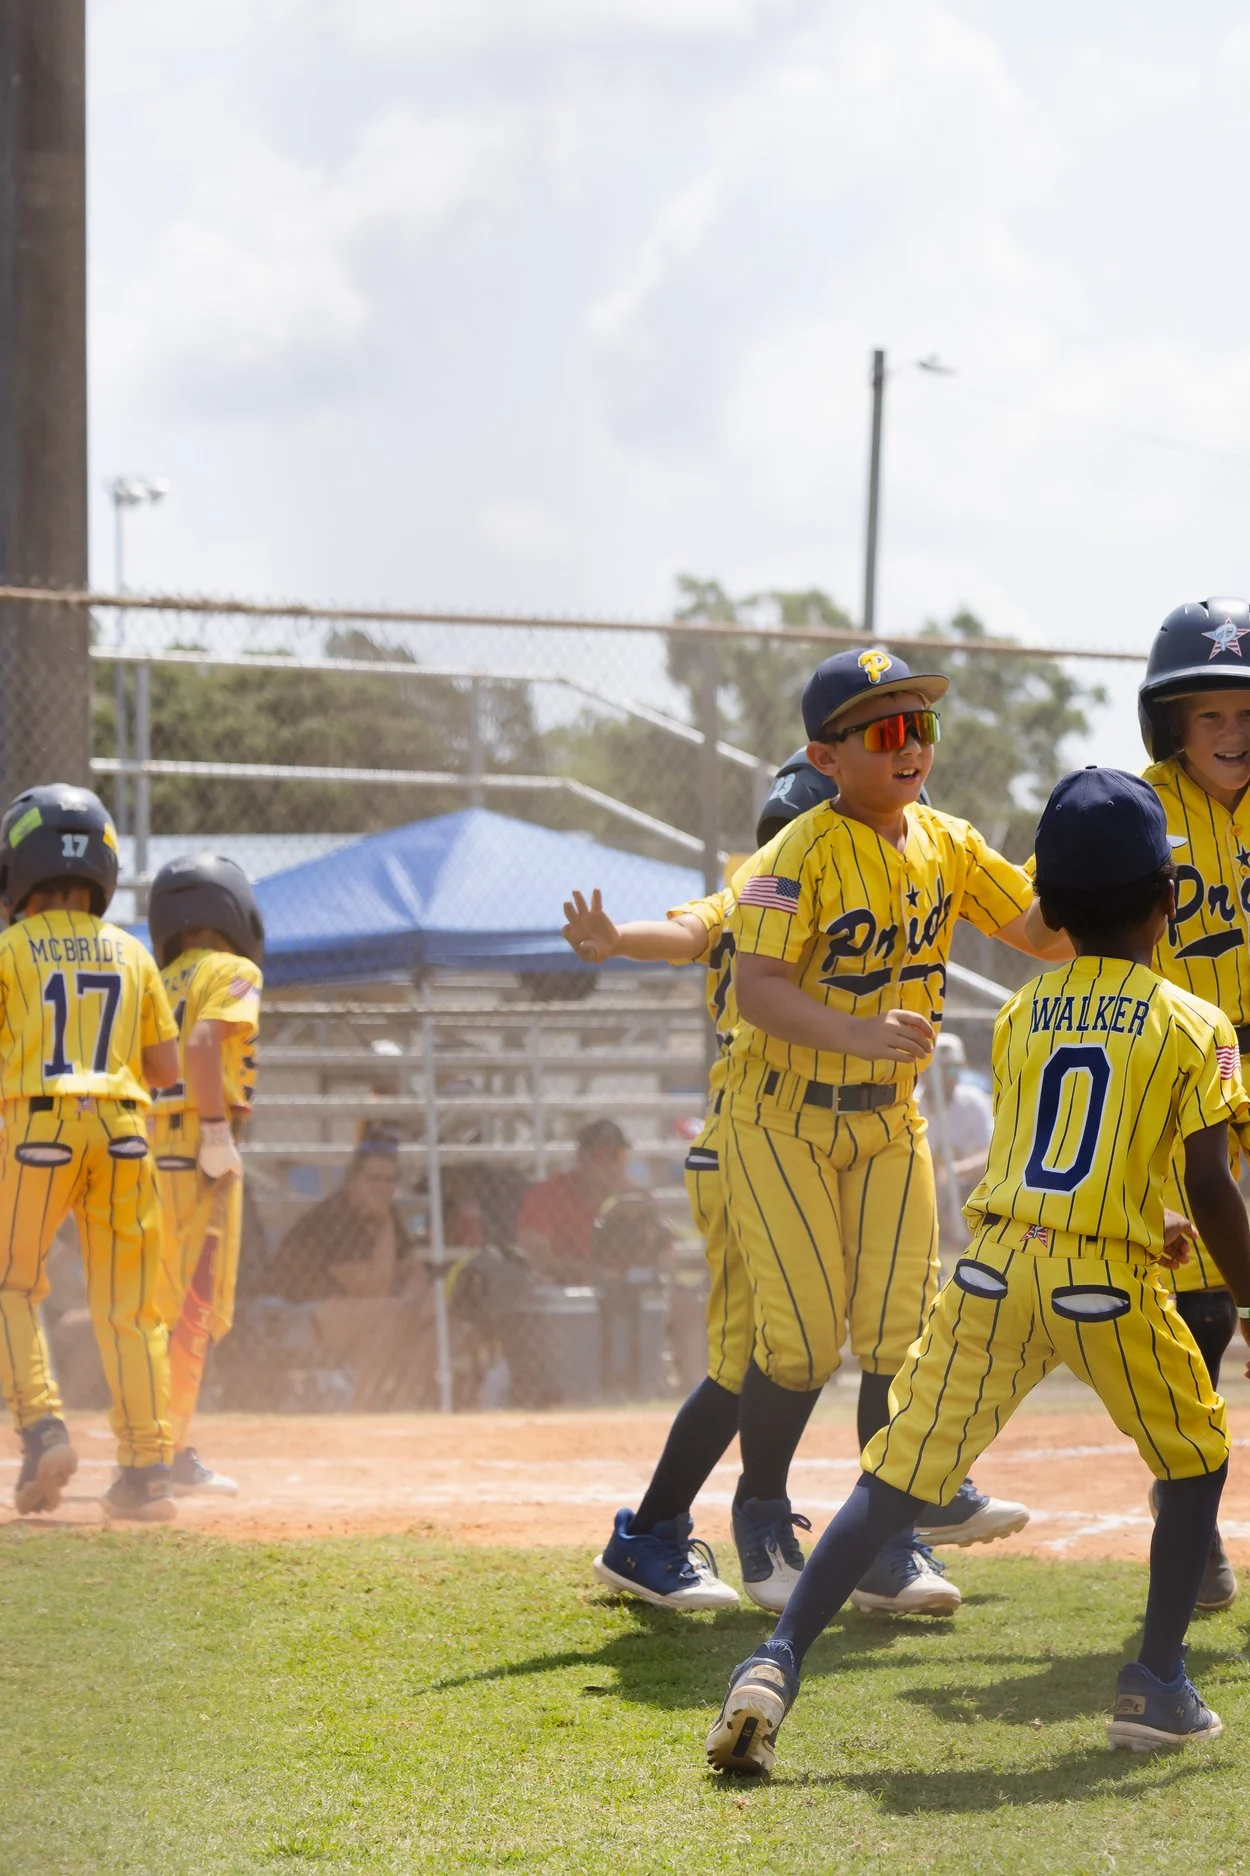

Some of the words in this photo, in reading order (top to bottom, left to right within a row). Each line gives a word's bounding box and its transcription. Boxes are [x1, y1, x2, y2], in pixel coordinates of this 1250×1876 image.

[857, 650, 892, 684] P
[61, 833, 89, 858] 17
[28, 937, 125, 965] MCBRIDE
[43, 970, 122, 1078] 17
[1031, 995, 1150, 1037] WALKER
[1022, 1043, 1112, 1195] 0
